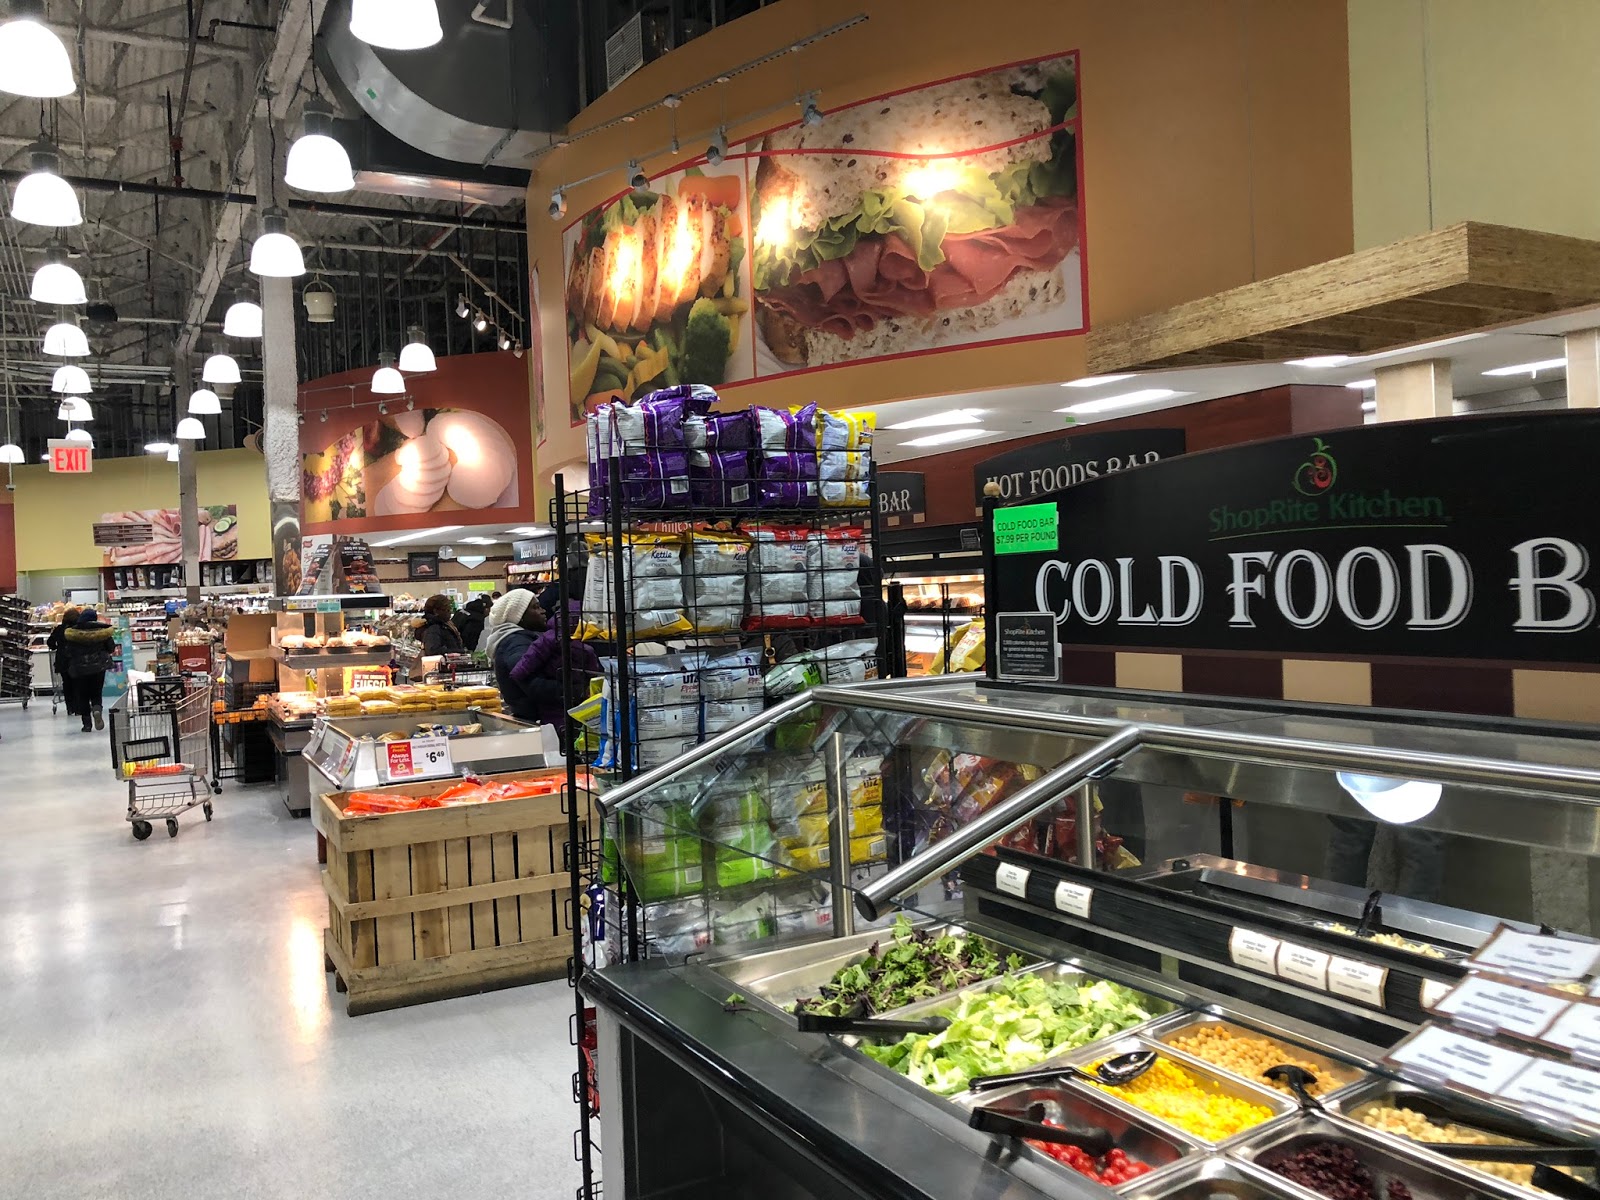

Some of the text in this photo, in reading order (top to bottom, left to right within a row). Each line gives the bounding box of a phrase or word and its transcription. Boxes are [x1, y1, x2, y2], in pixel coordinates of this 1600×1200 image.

[55, 448, 87, 471] EXIT
[1029, 461, 1099, 494] FOODS
[879, 489, 911, 513] BAR
[1208, 489, 1444, 533] ShopRite Kitchen
[997, 517, 1054, 531] COLD FOOD BAR
[996, 530, 1056, 544] $7.99 PER POUND
[651, 551, 672, 560] Kettle
[1035, 556, 1204, 626] COLD
[1226, 544, 1474, 630] FOOD
